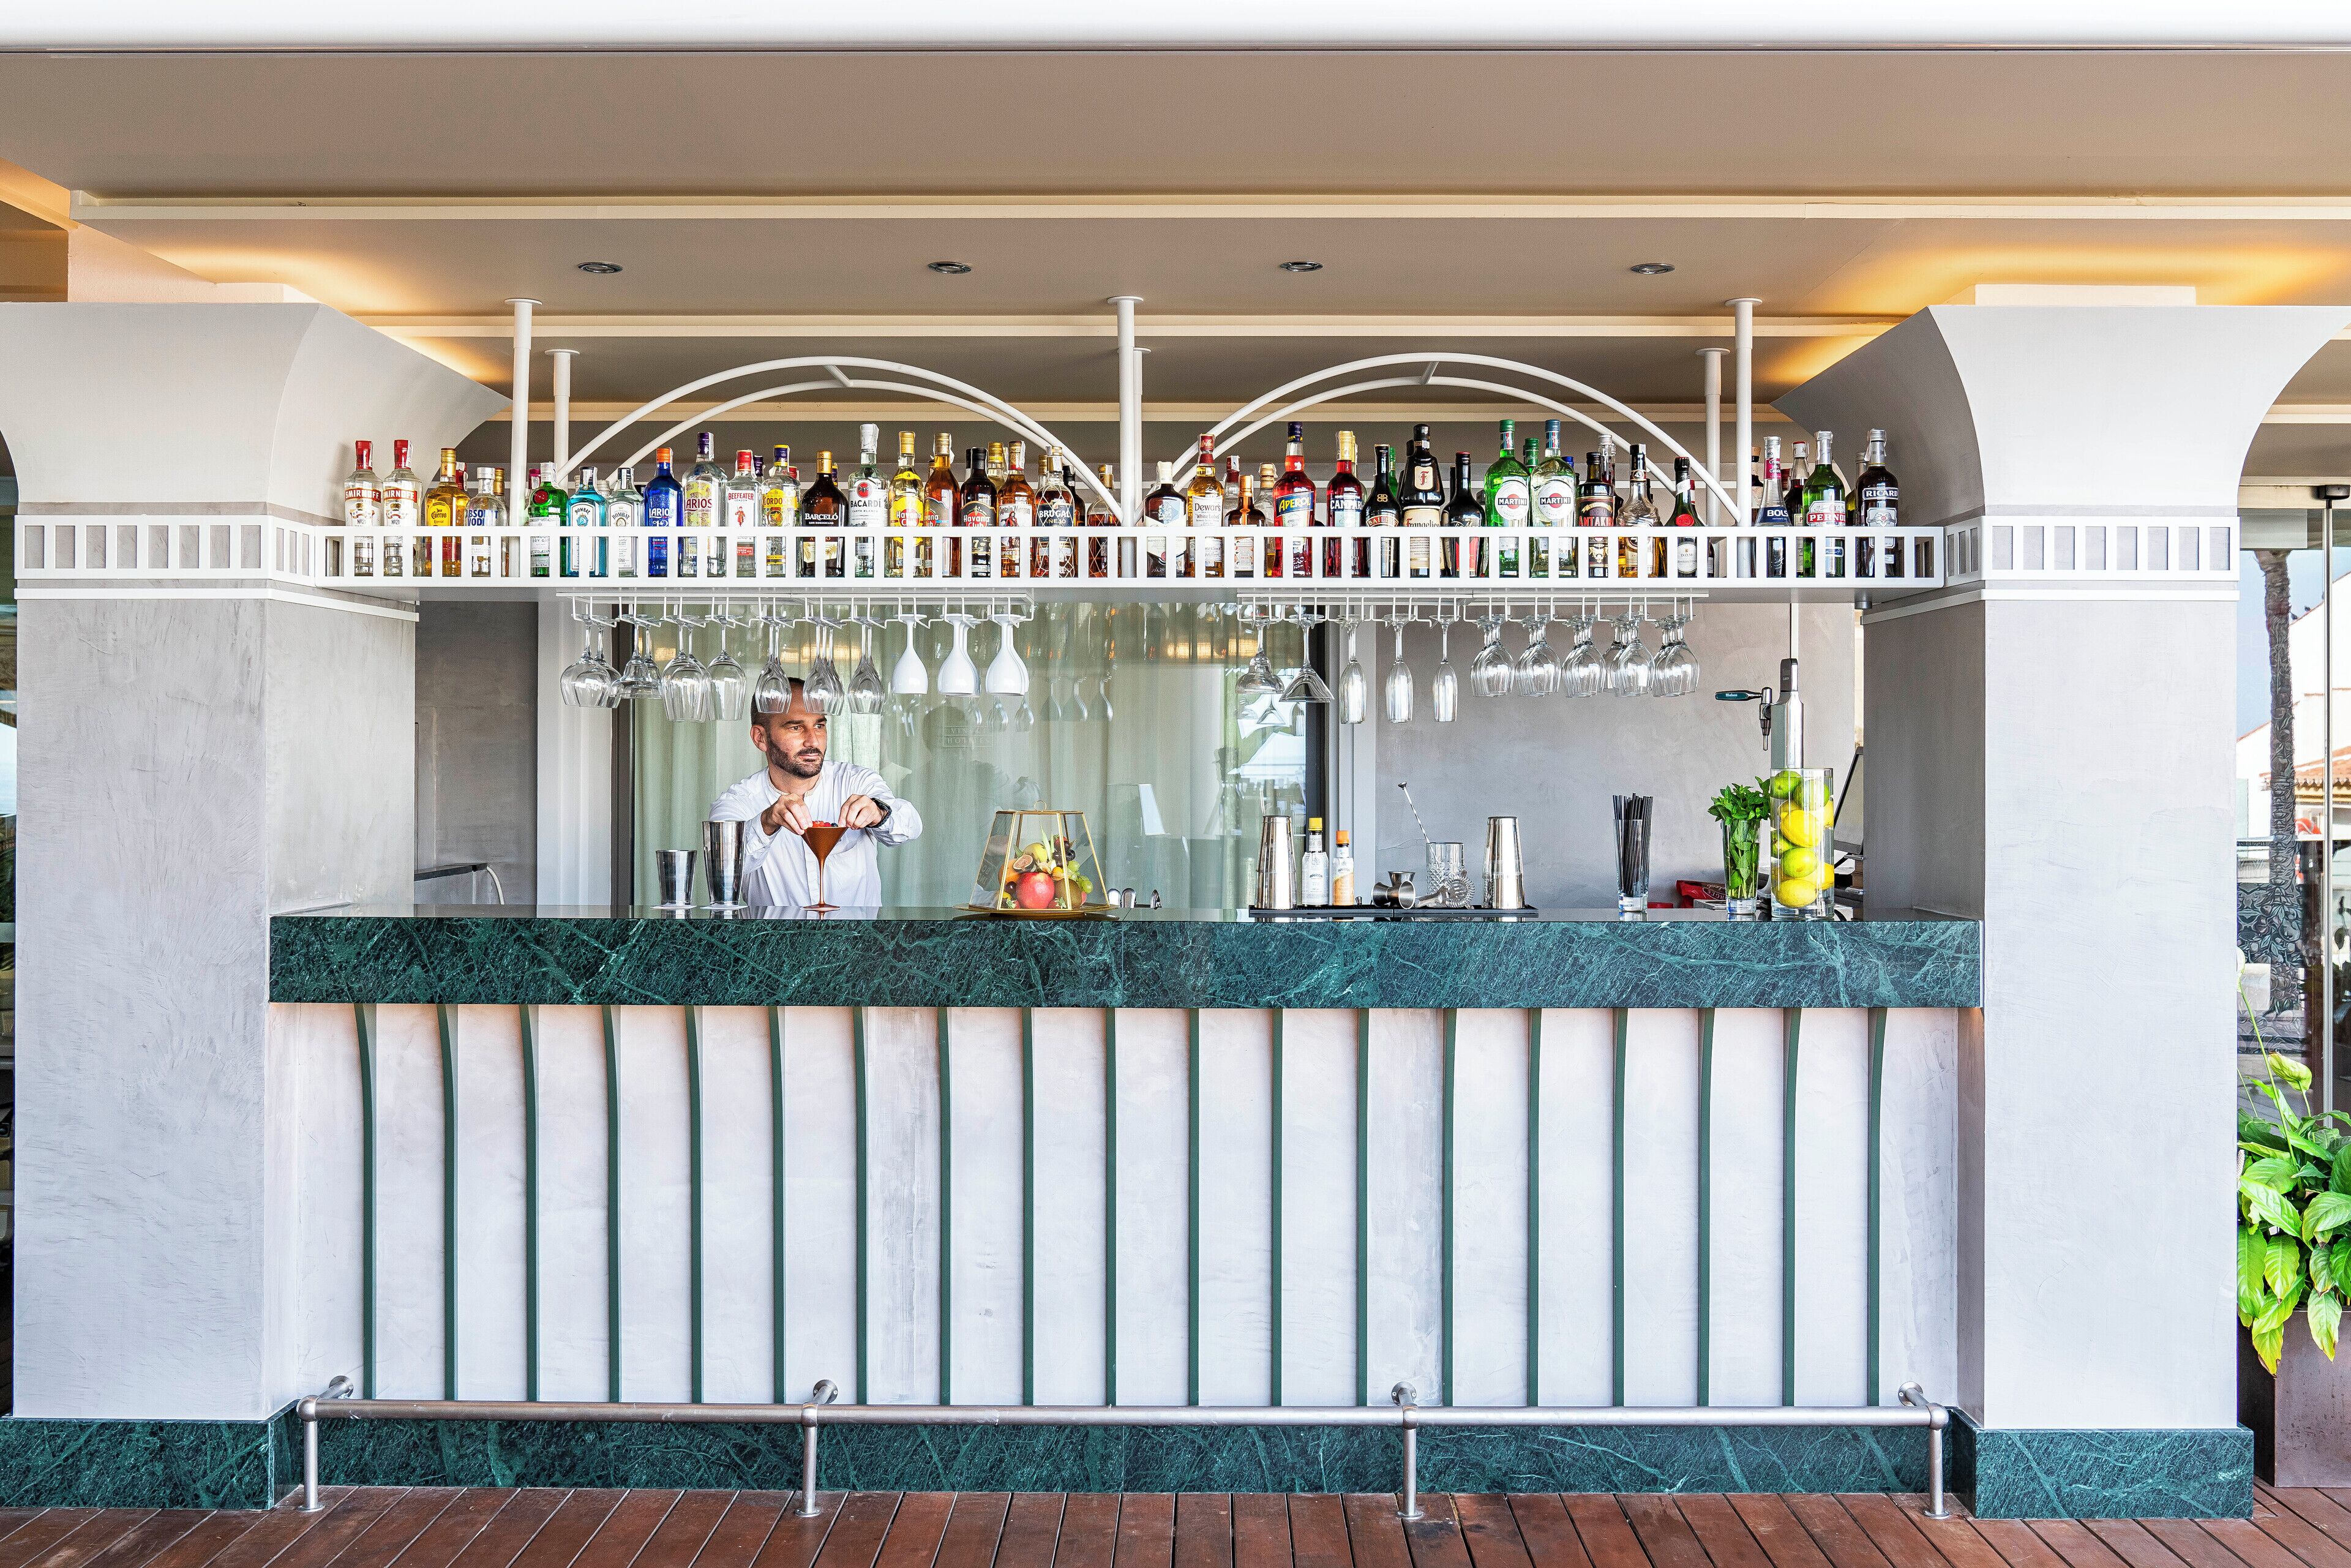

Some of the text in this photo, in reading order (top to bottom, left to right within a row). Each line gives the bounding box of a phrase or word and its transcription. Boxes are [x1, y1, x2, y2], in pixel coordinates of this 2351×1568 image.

[728, 492, 754, 501] BEEFEATER
[684, 498, 713, 511] LARIOS
[850, 498, 881, 508] BACARDÍ
[1194, 503, 1221, 512] Dewar's
[1279, 497, 1311, 512] APEROL
[1330, 500, 1362, 510] CAMPARI
[649, 508, 674, 518] LARIOS
[896, 511, 921, 519] Havana
[999, 505, 1030, 516] Captain Morgan
[1368, 516, 1398, 526] BAILEYS
[1809, 513, 1845, 522] PERNO
[973, 539, 980, 548] 7
